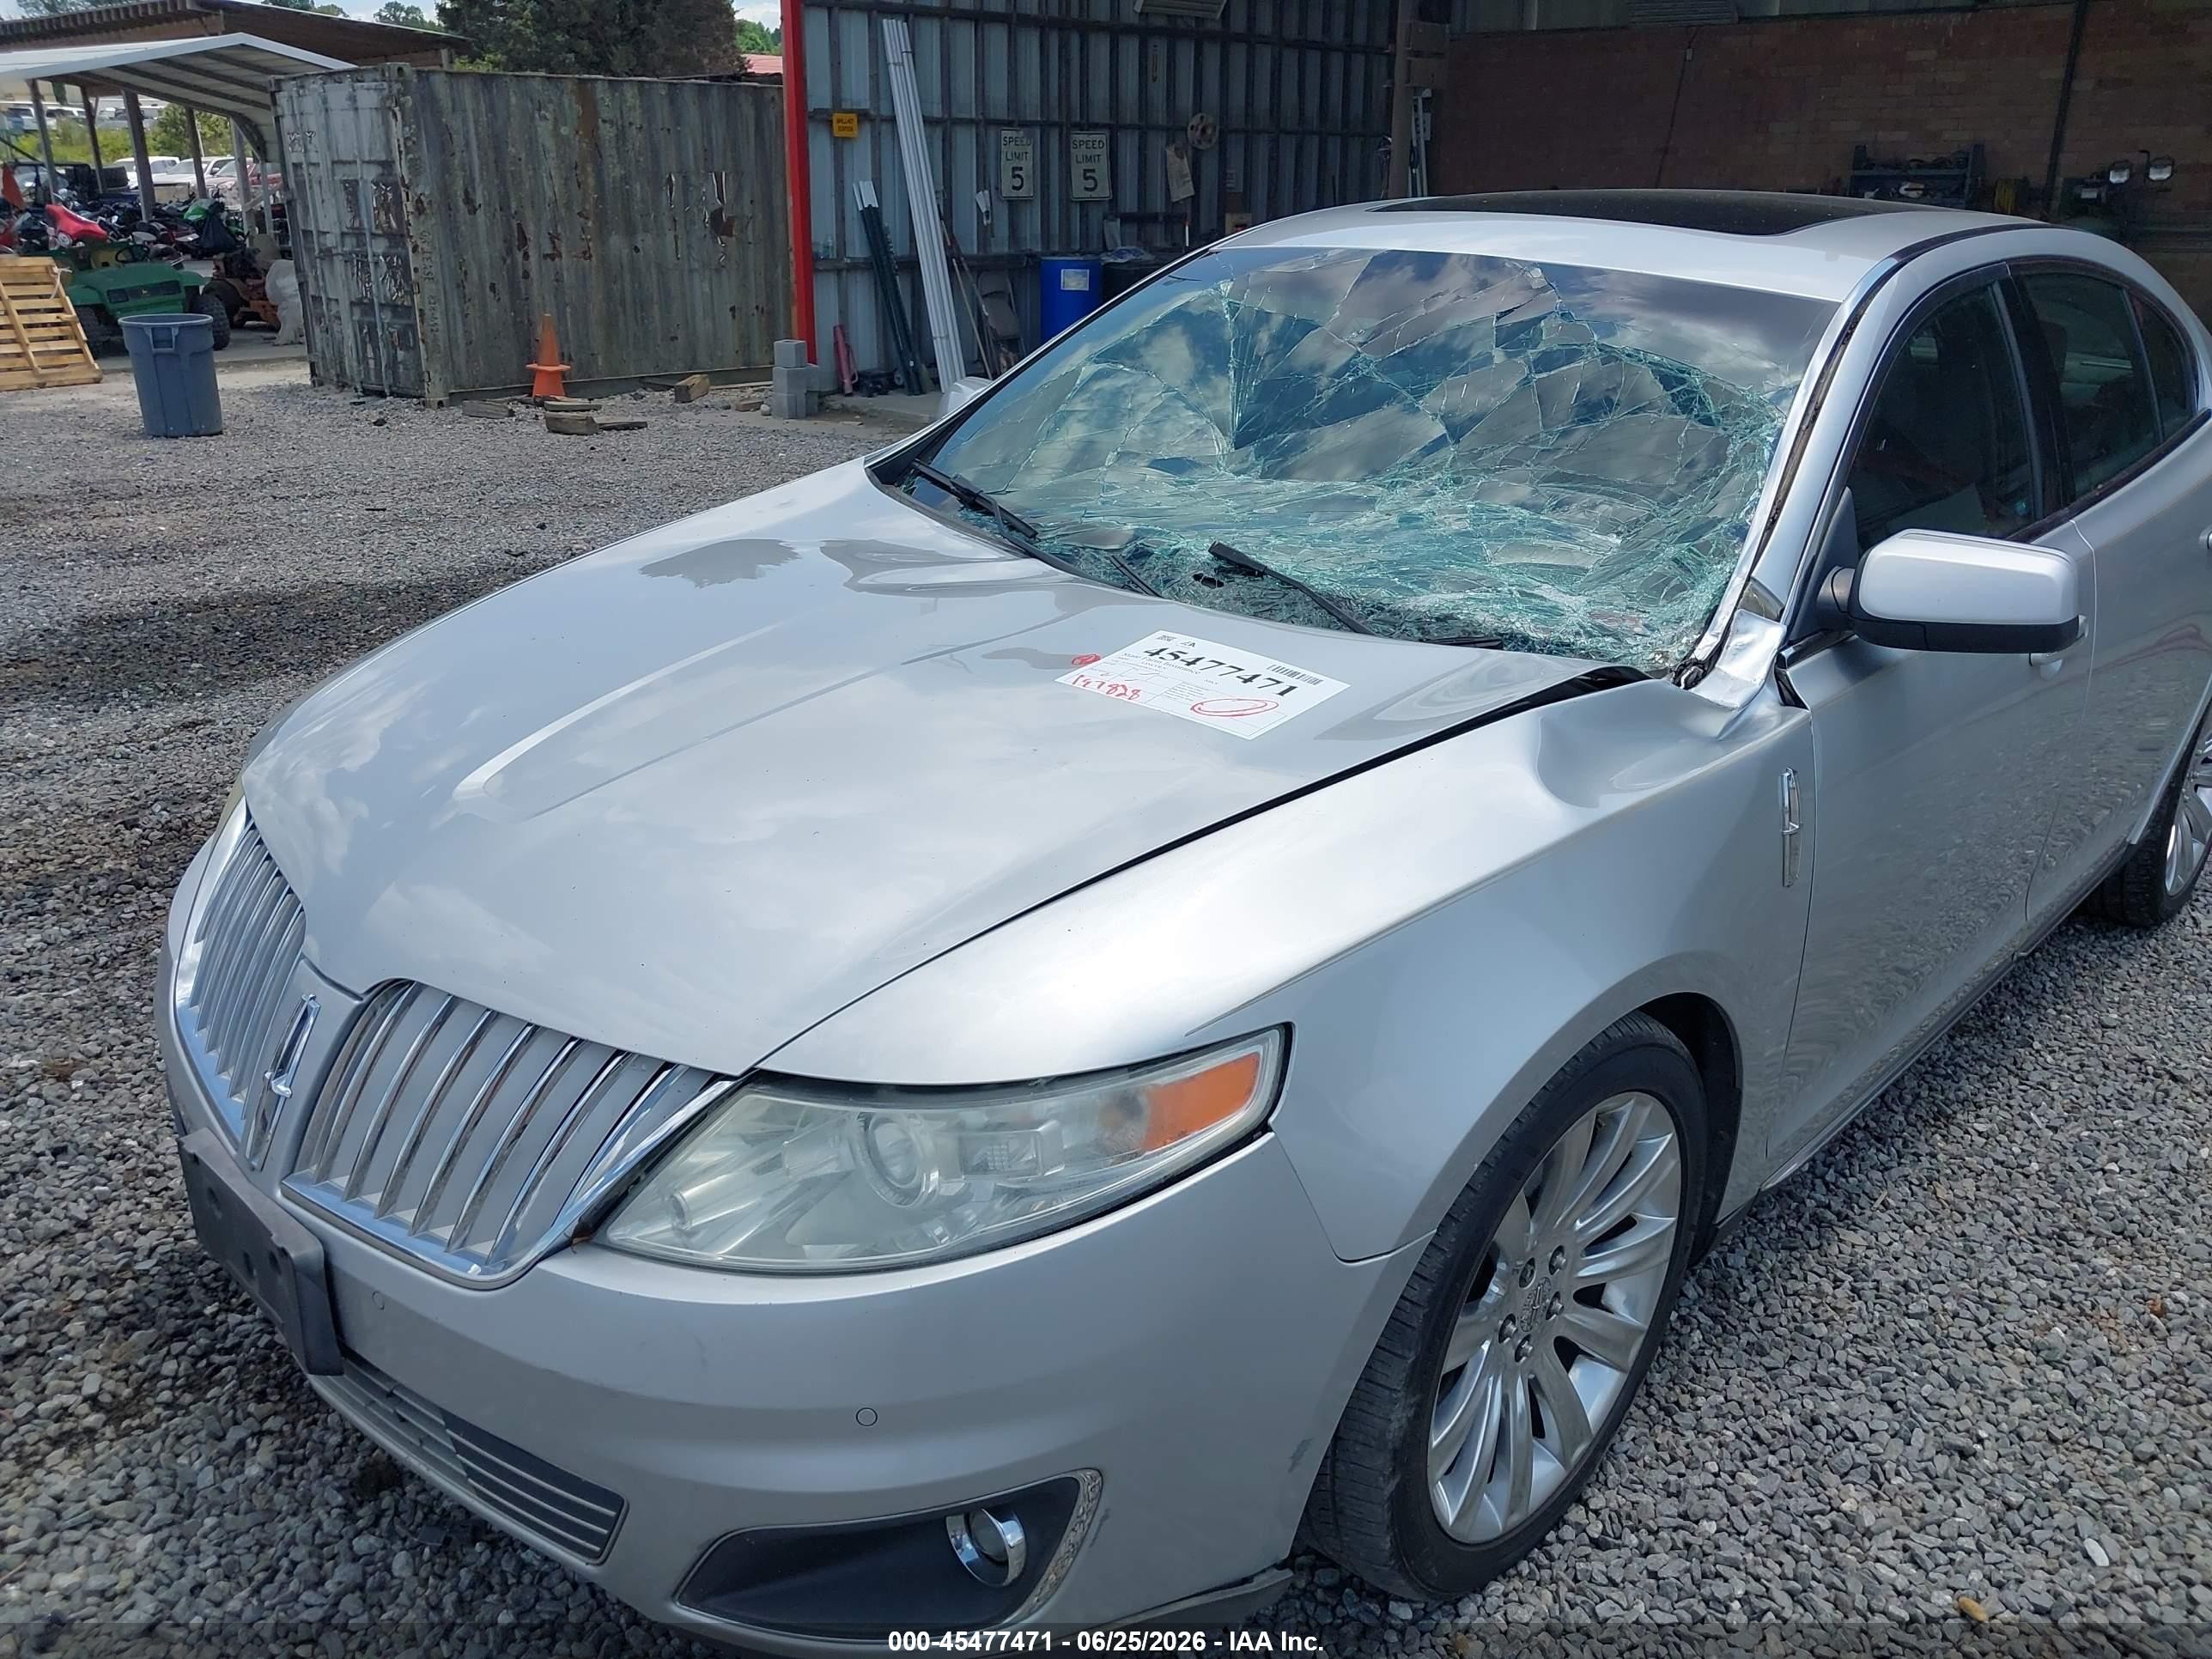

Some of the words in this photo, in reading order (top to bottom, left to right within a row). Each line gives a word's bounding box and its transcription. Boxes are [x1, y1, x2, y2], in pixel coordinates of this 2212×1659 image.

[1002, 136, 1032, 147] SPEED
[1072, 139, 1105, 149] SPEED
[1006, 151, 1029, 161] LIMIT
[1075, 154, 1101, 164] LIMIT
[1011, 166, 1024, 191] 5
[1083, 168, 1098, 191] 5
[1144, 647, 1298, 696] 45477471
